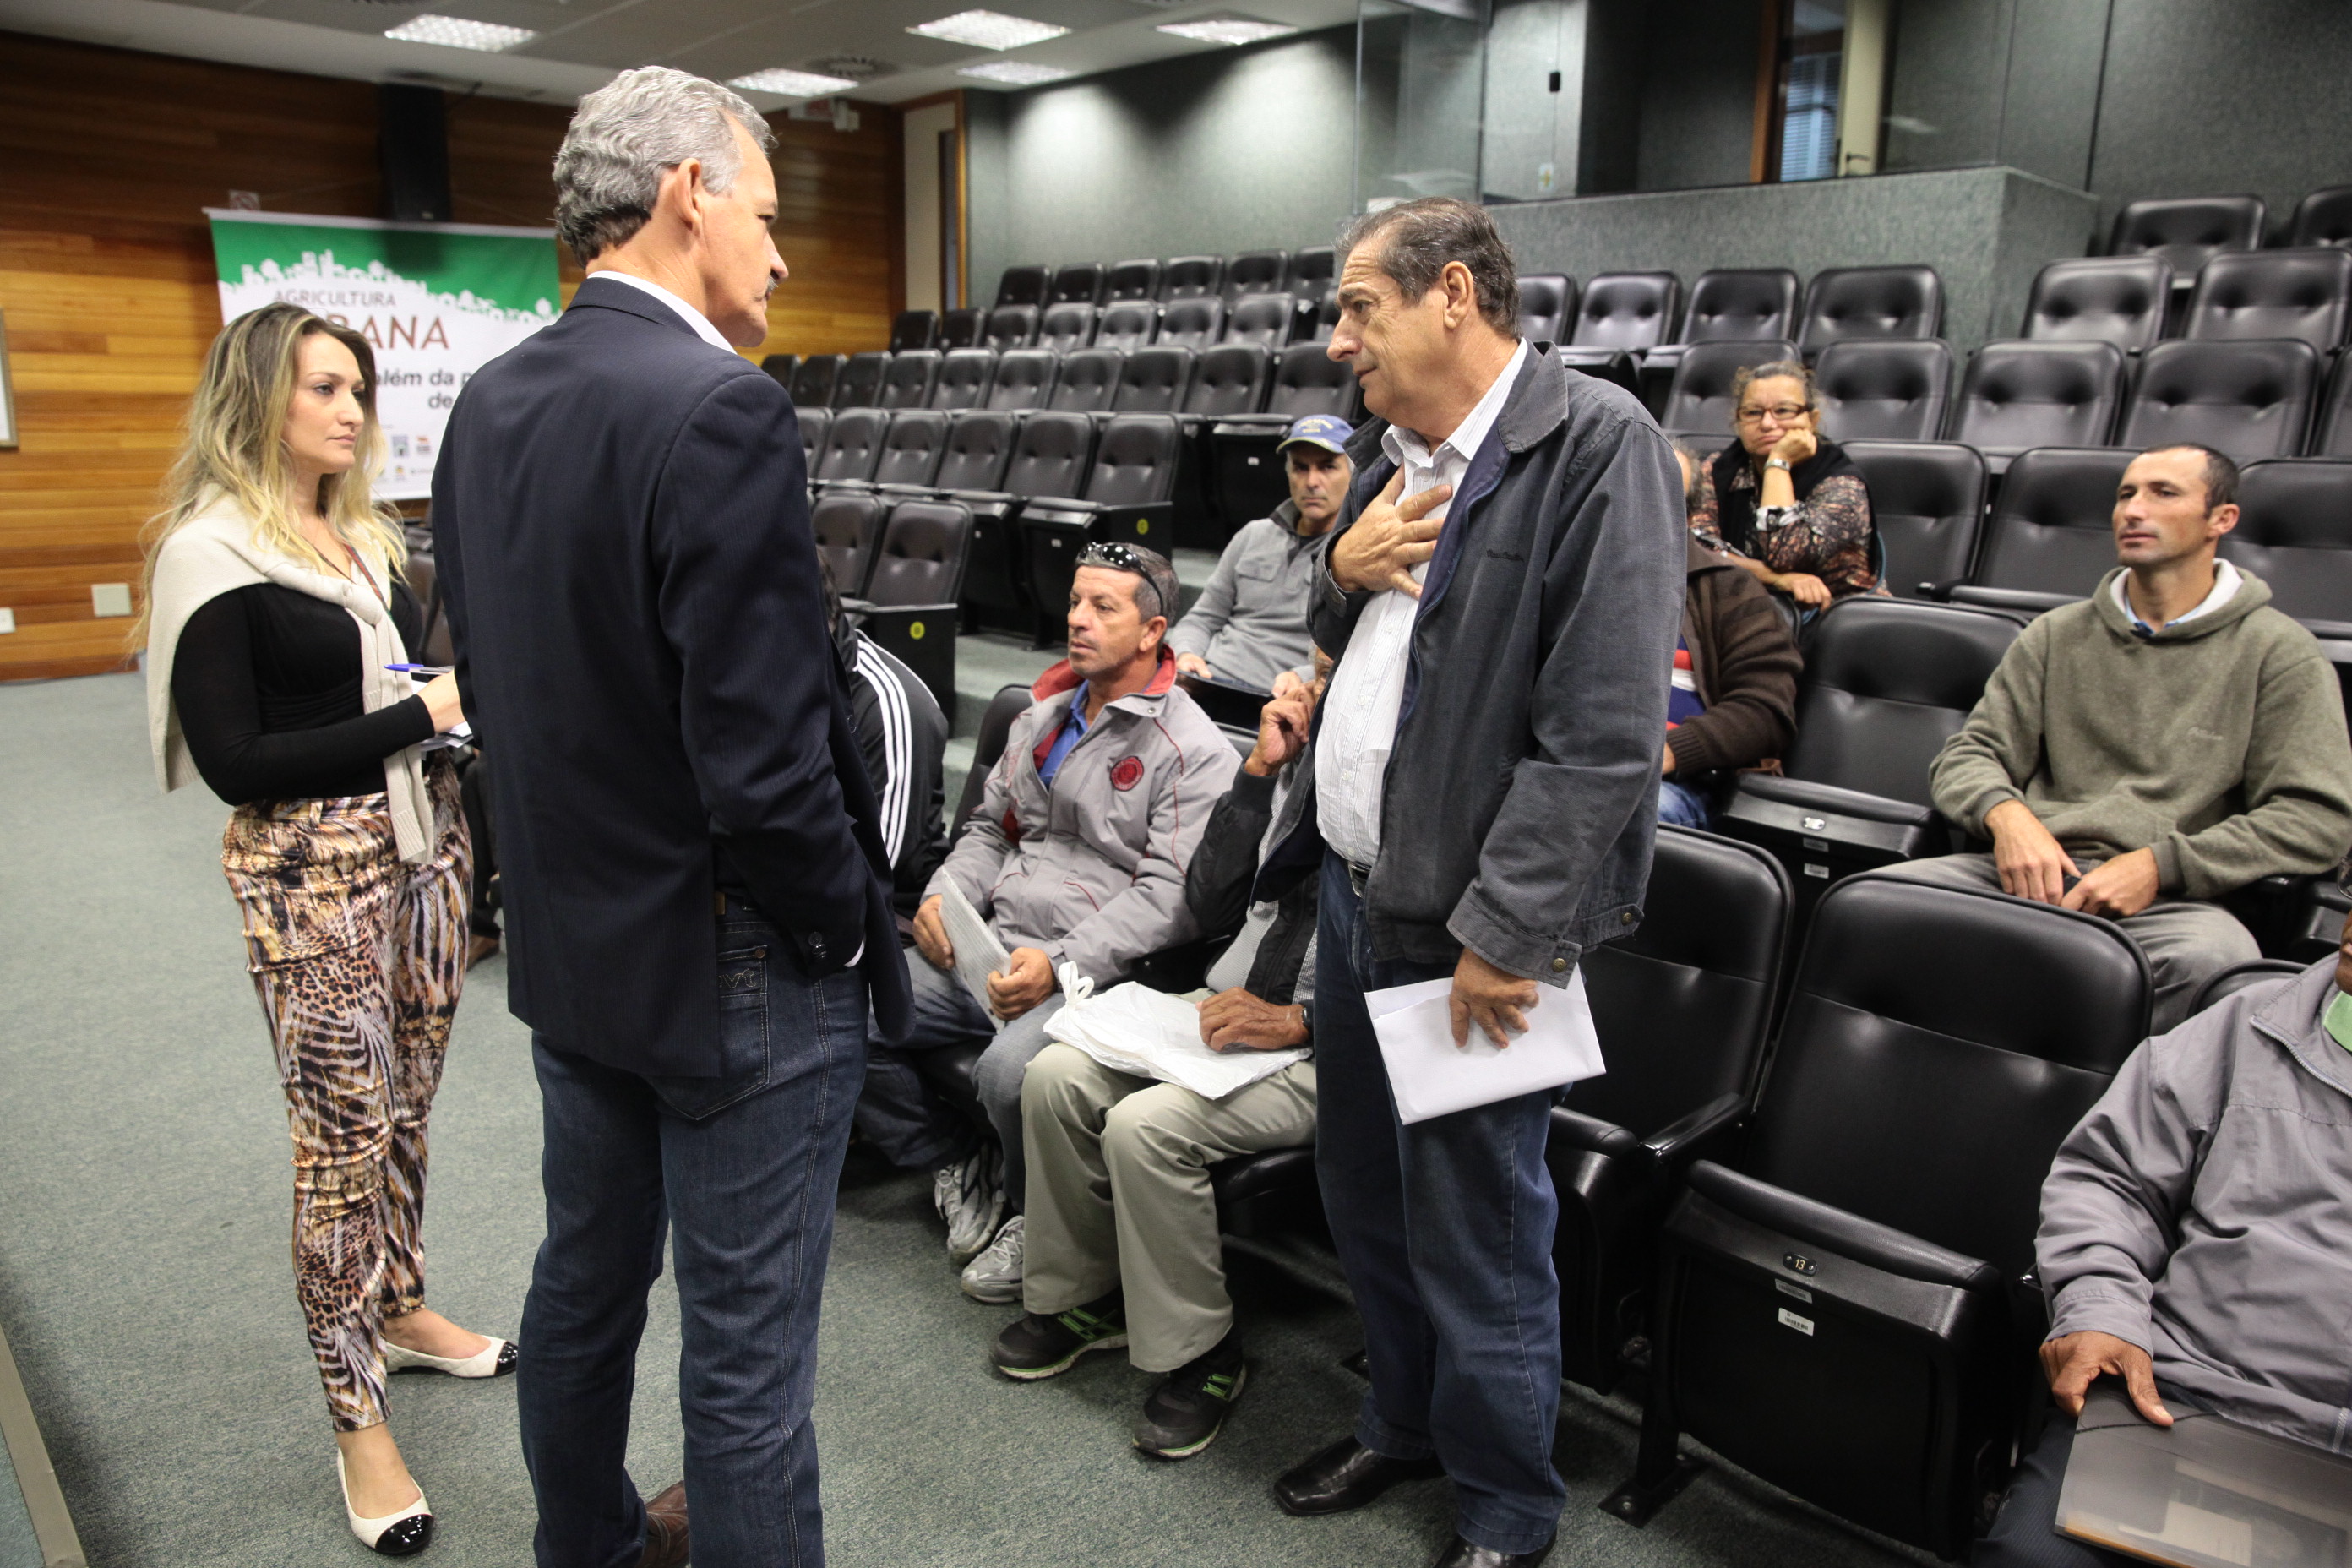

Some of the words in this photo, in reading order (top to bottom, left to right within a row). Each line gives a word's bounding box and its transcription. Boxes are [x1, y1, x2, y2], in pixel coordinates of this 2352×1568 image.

[274, 289, 396, 307] AGRICULTURA
[429, 369, 454, 385] da
[428, 393, 453, 409] de
[1795, 1258, 1805, 1270] 13
